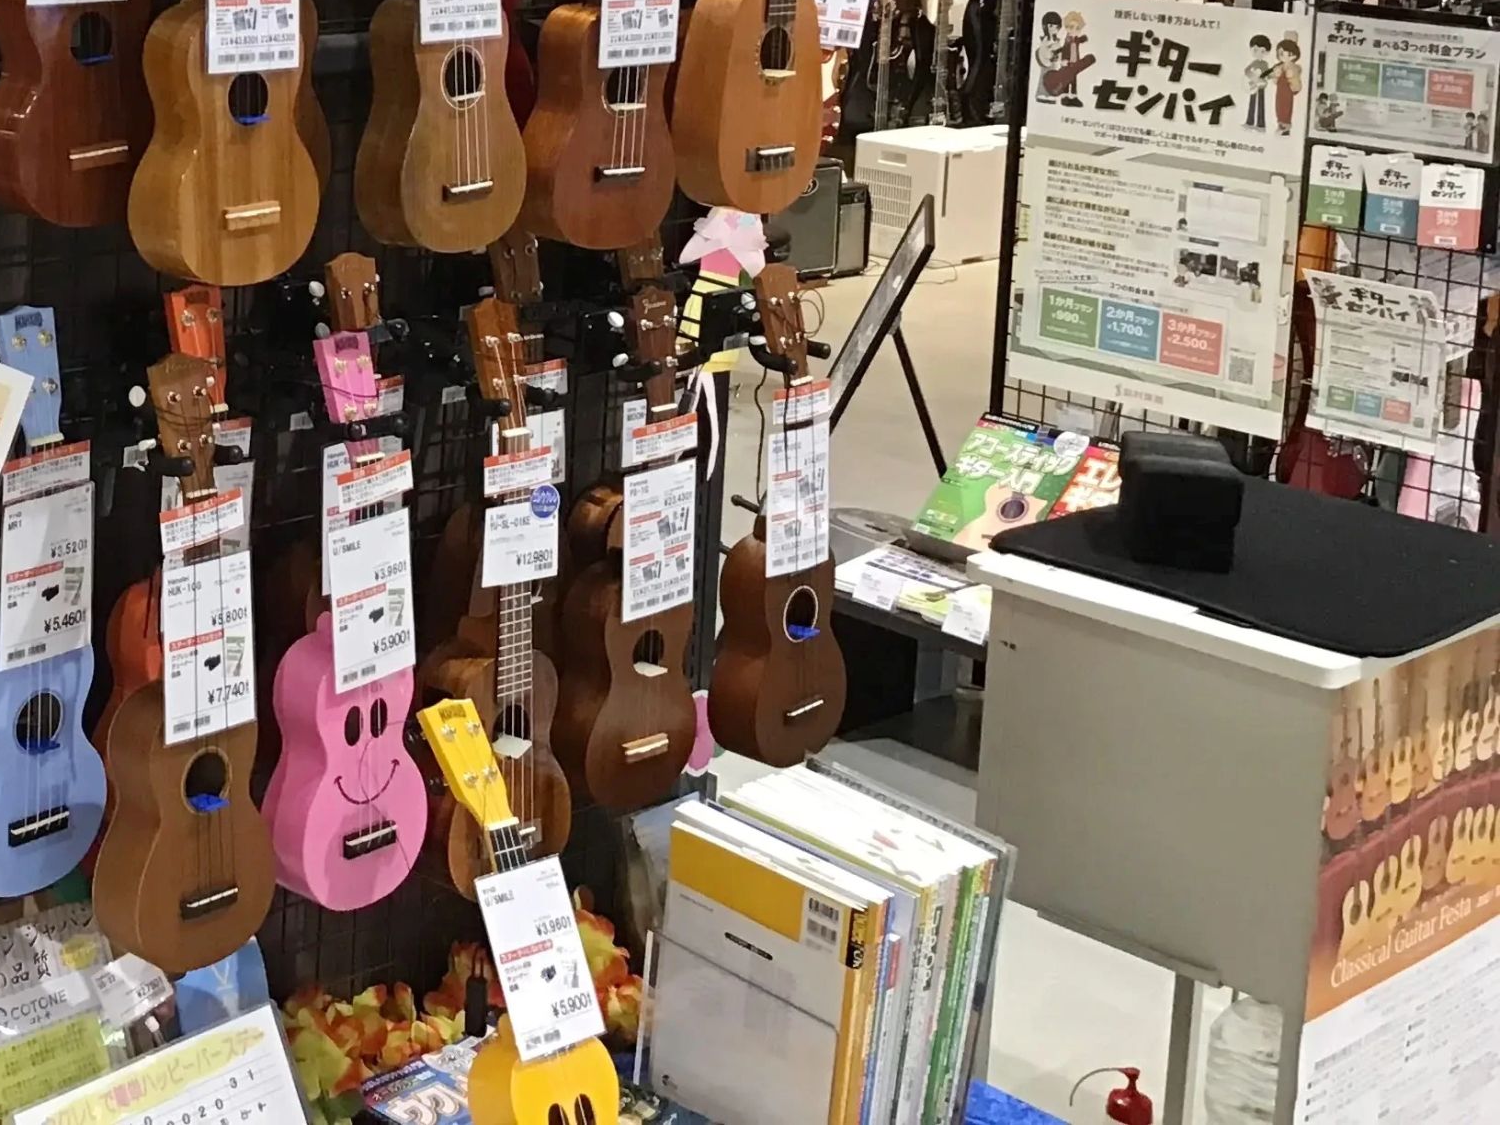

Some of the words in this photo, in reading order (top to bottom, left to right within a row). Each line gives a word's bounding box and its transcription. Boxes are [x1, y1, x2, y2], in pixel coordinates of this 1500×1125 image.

[1334, 20, 1364, 35] ギター
[1327, 34, 1366, 46] センパイ
[1115, 29, 1222, 83] ギター
[1092, 79, 1235, 125] センパイ
[1325, 160, 1350, 170] ギター
[1436, 179, 1463, 190] ギター
[1350, 287, 1400, 305] ギター
[1345, 301, 1410, 322] センパイ
[967, 432, 1082, 475] アコースティック
[44, 610, 82, 633] ¥5,460
[373, 630, 406, 654] ¥5,900
[208, 681, 245, 704] ¥7,740
[1330, 934, 1392, 988] Classical
[1394, 915, 1437, 954] Guitar
[1439, 896, 1472, 930] Festa
[11, 989, 68, 1021] COTONE
[551, 992, 588, 1018] ¥5,900
